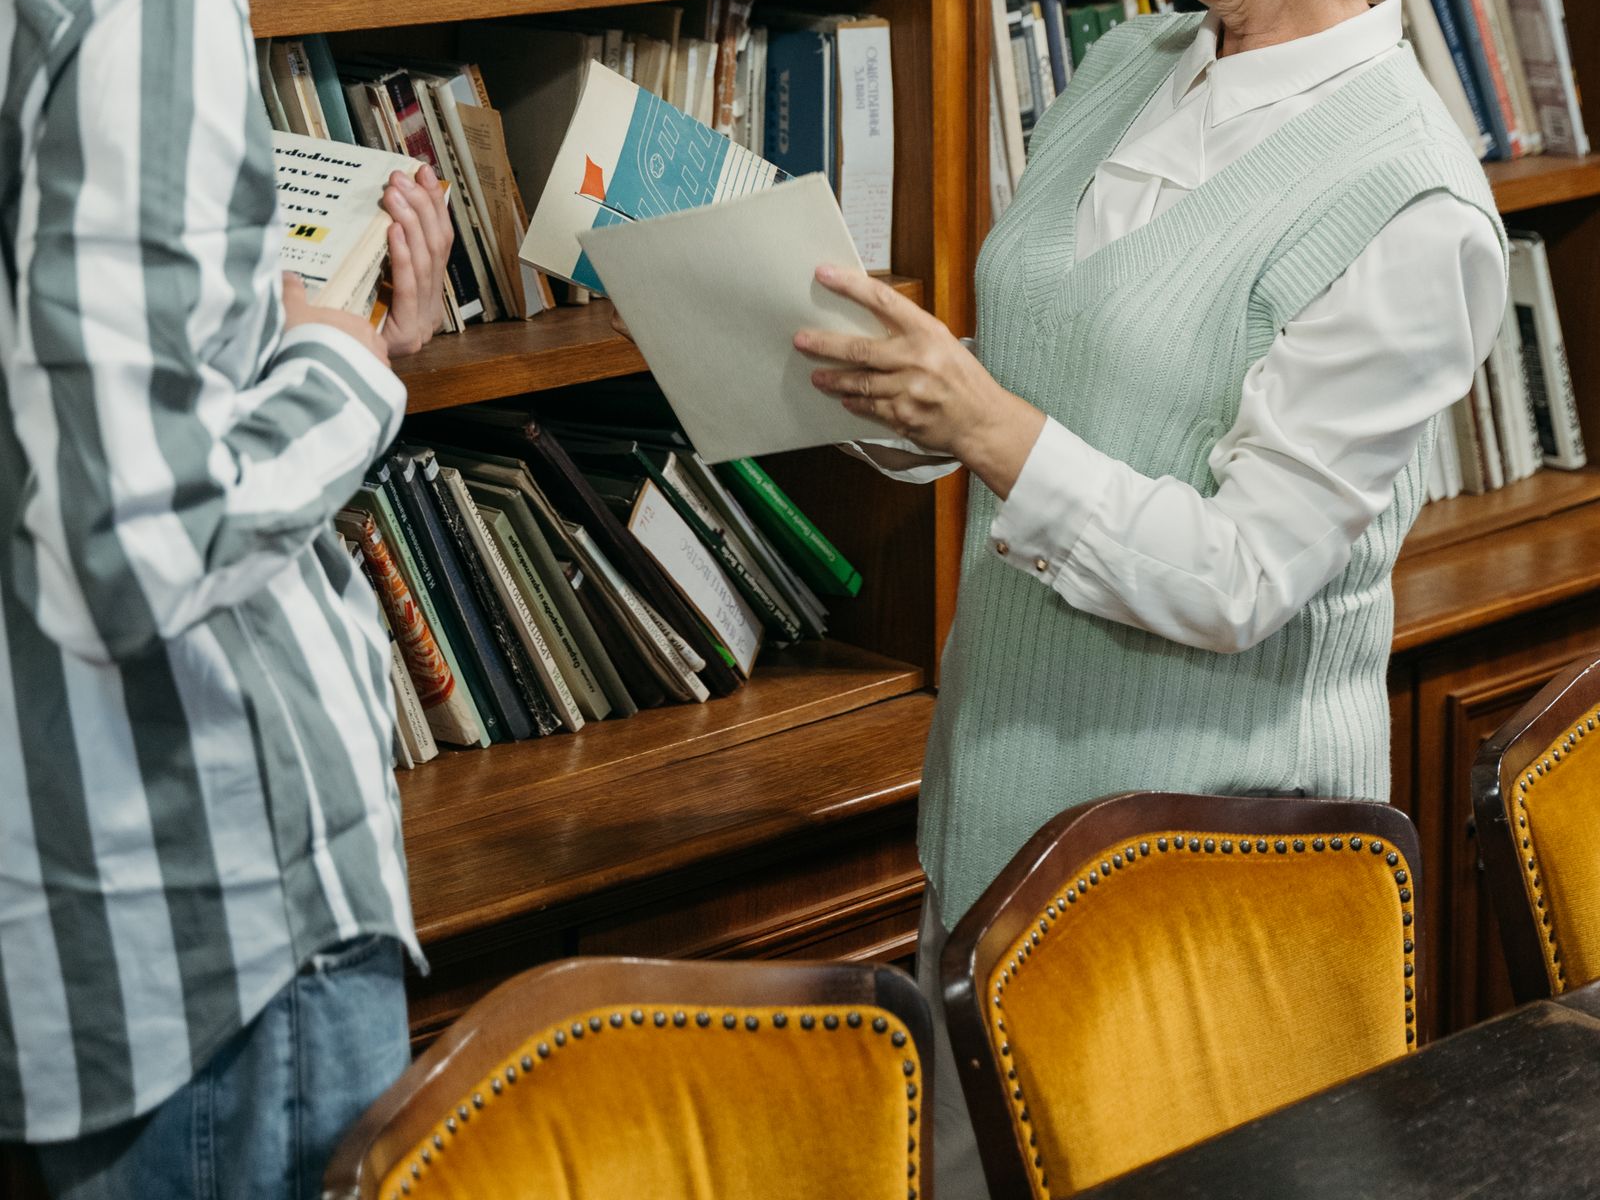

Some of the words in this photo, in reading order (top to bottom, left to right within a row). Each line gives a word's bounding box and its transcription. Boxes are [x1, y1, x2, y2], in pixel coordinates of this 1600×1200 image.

[505, 533, 543, 594] архитектура
[537, 592, 545, 600] и
[539, 598, 566, 637] природы
[558, 635, 582, 669] Охрана
